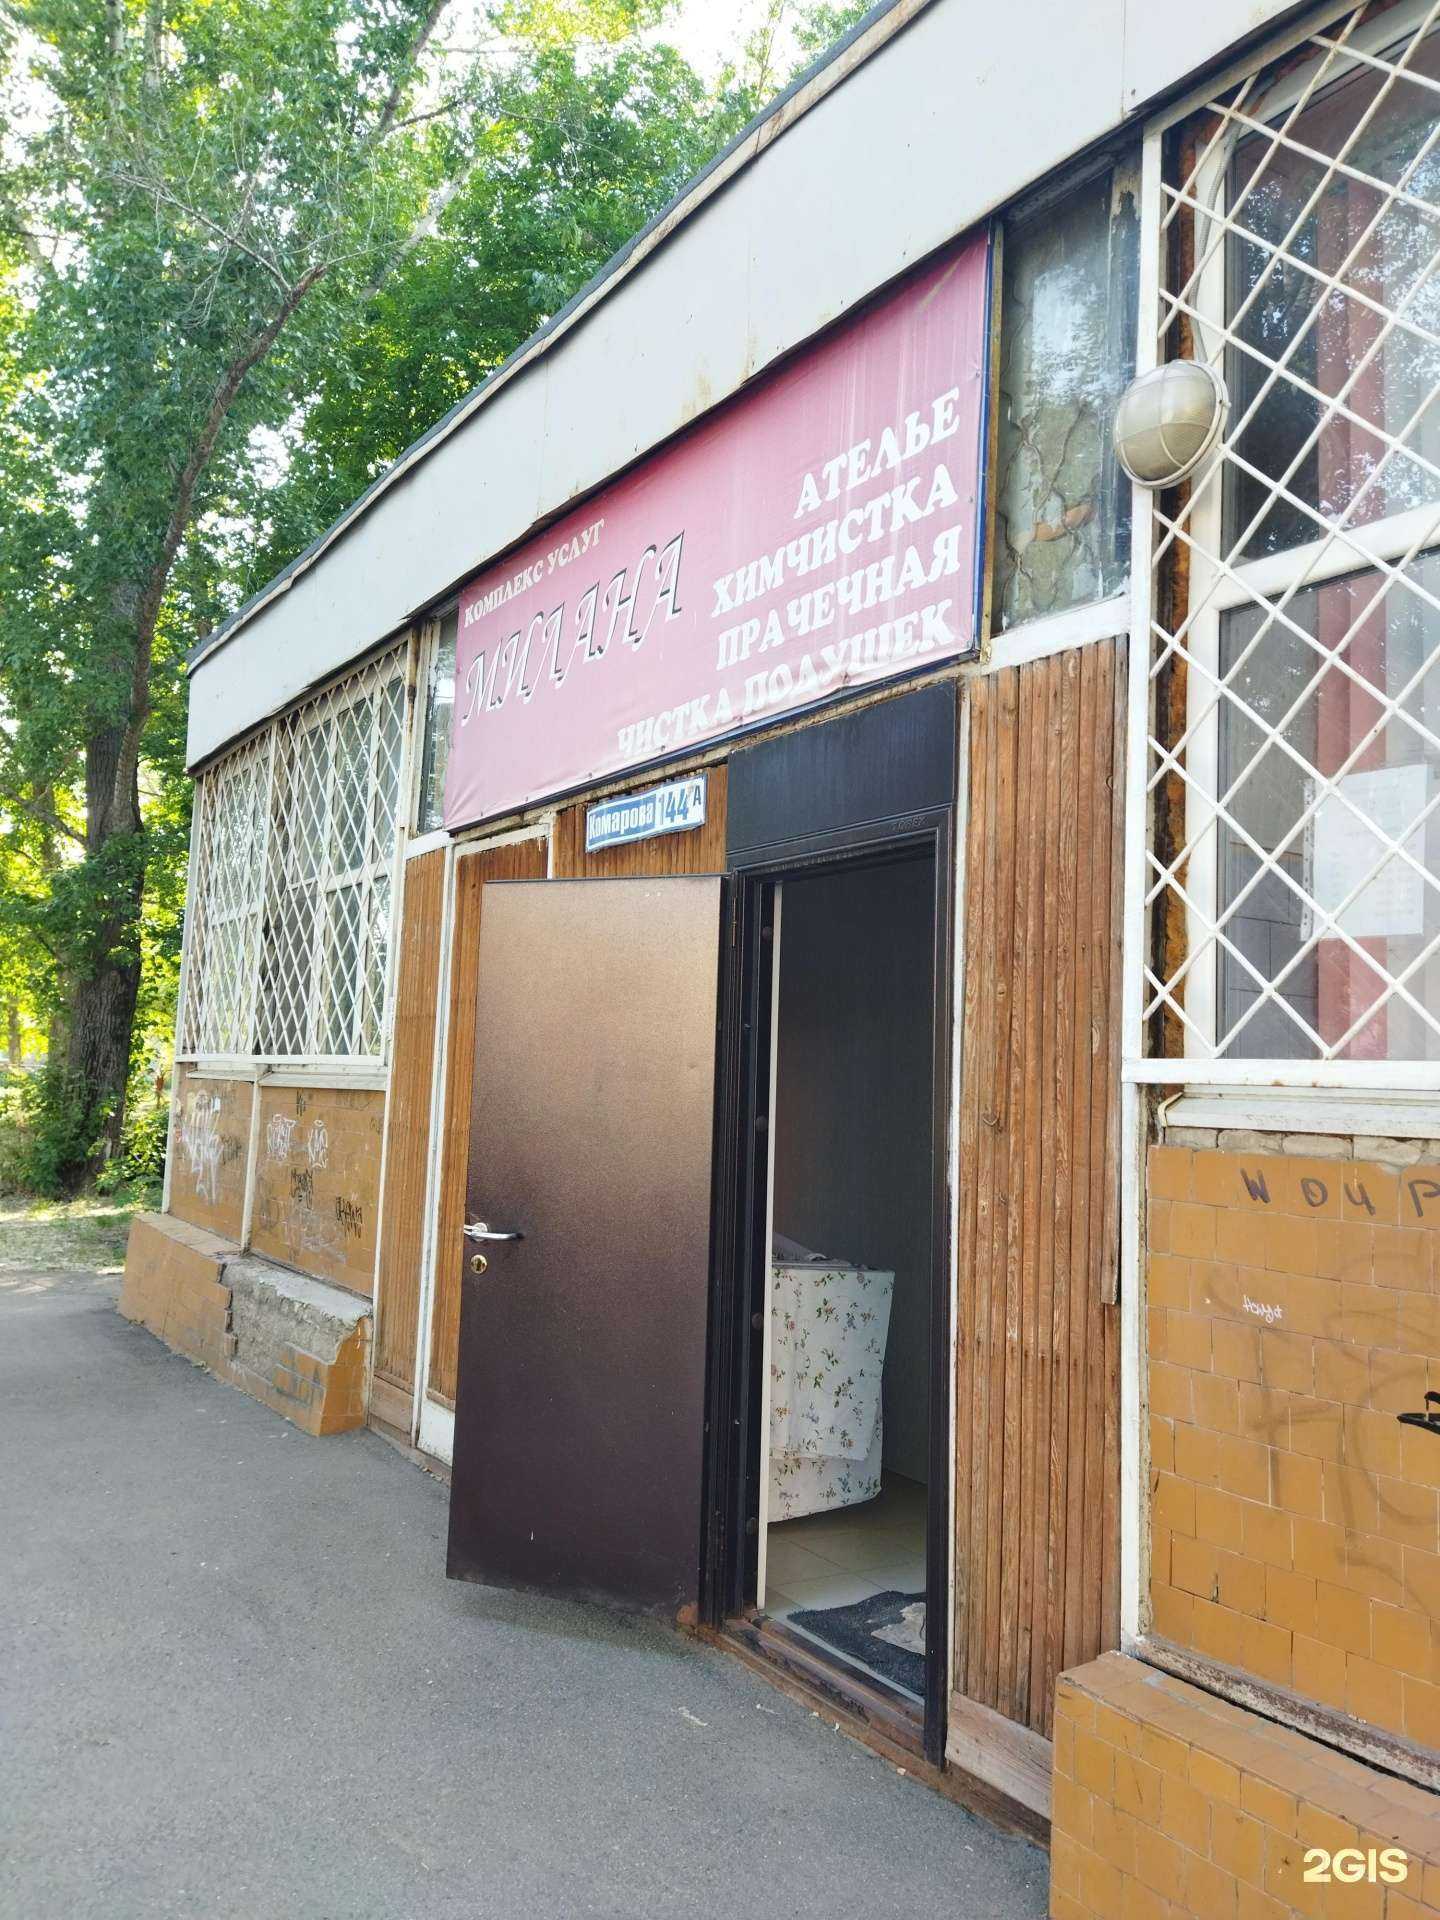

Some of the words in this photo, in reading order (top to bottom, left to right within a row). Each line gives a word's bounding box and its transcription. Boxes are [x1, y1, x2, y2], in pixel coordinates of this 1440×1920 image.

[793, 387, 960, 519] АТЕЛЬЕ
[464, 559, 545, 628] КОМПЛЕКС
[547, 518, 605, 575] УСЛУГ
[711, 463, 959, 618] ХИМЧИСТКА
[716, 524, 962, 671] ПРАЧЕЧНАЯ
[461, 528, 685, 727] МИЛАНА
[617, 687, 733, 754] ЧИСТКА
[742, 598, 956, 717] ПОДУШЕК
[588, 802, 654, 839] Комарова
